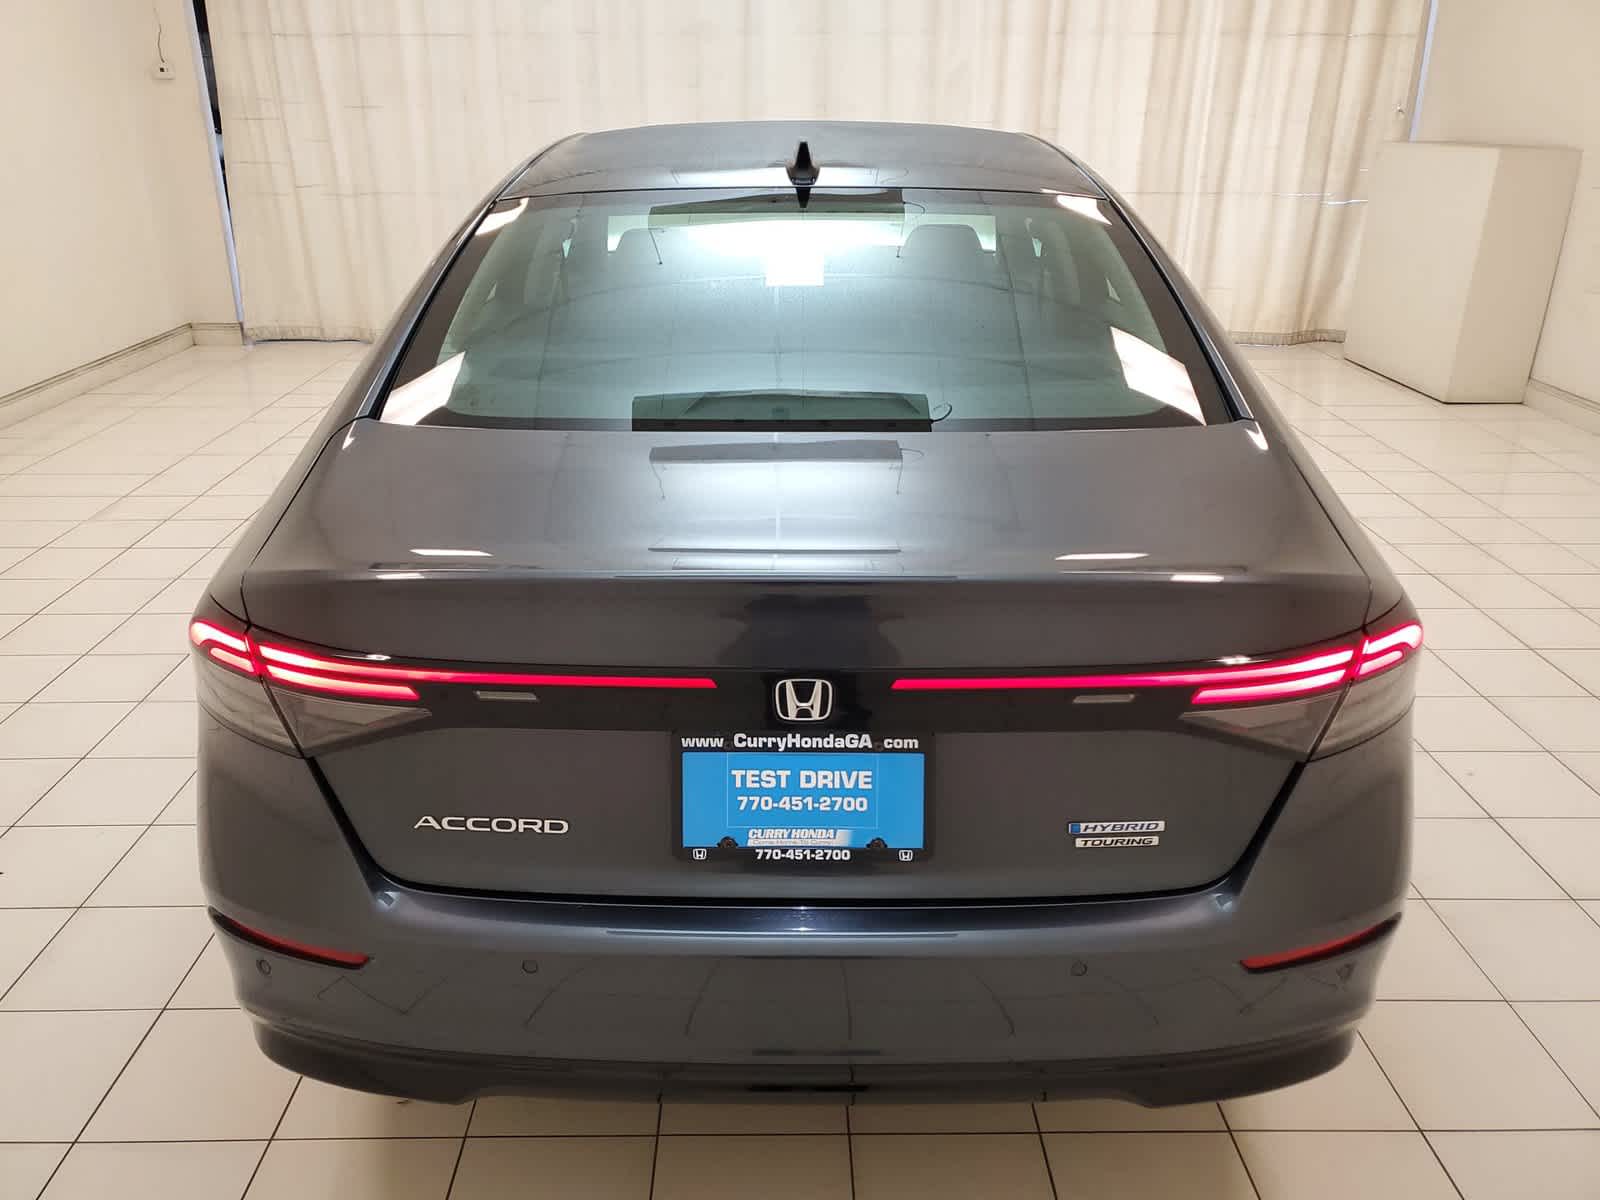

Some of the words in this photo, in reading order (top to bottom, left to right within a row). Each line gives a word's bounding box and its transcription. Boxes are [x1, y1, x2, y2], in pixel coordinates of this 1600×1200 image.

[733, 733, 873, 751] CurryHondaGA
[731, 770, 792, 789] TEST
[800, 771, 873, 790] DRIVE
[737, 796, 868, 812] 770-451-2700
[413, 815, 570, 834] ACCORD
[1082, 822, 1160, 832] HYBRID
[748, 829, 791, 839] CURRY
[791, 829, 835, 839] HONDA
[1081, 837, 1153, 847] TOURING
[755, 849, 851, 860] 770-451-2700
